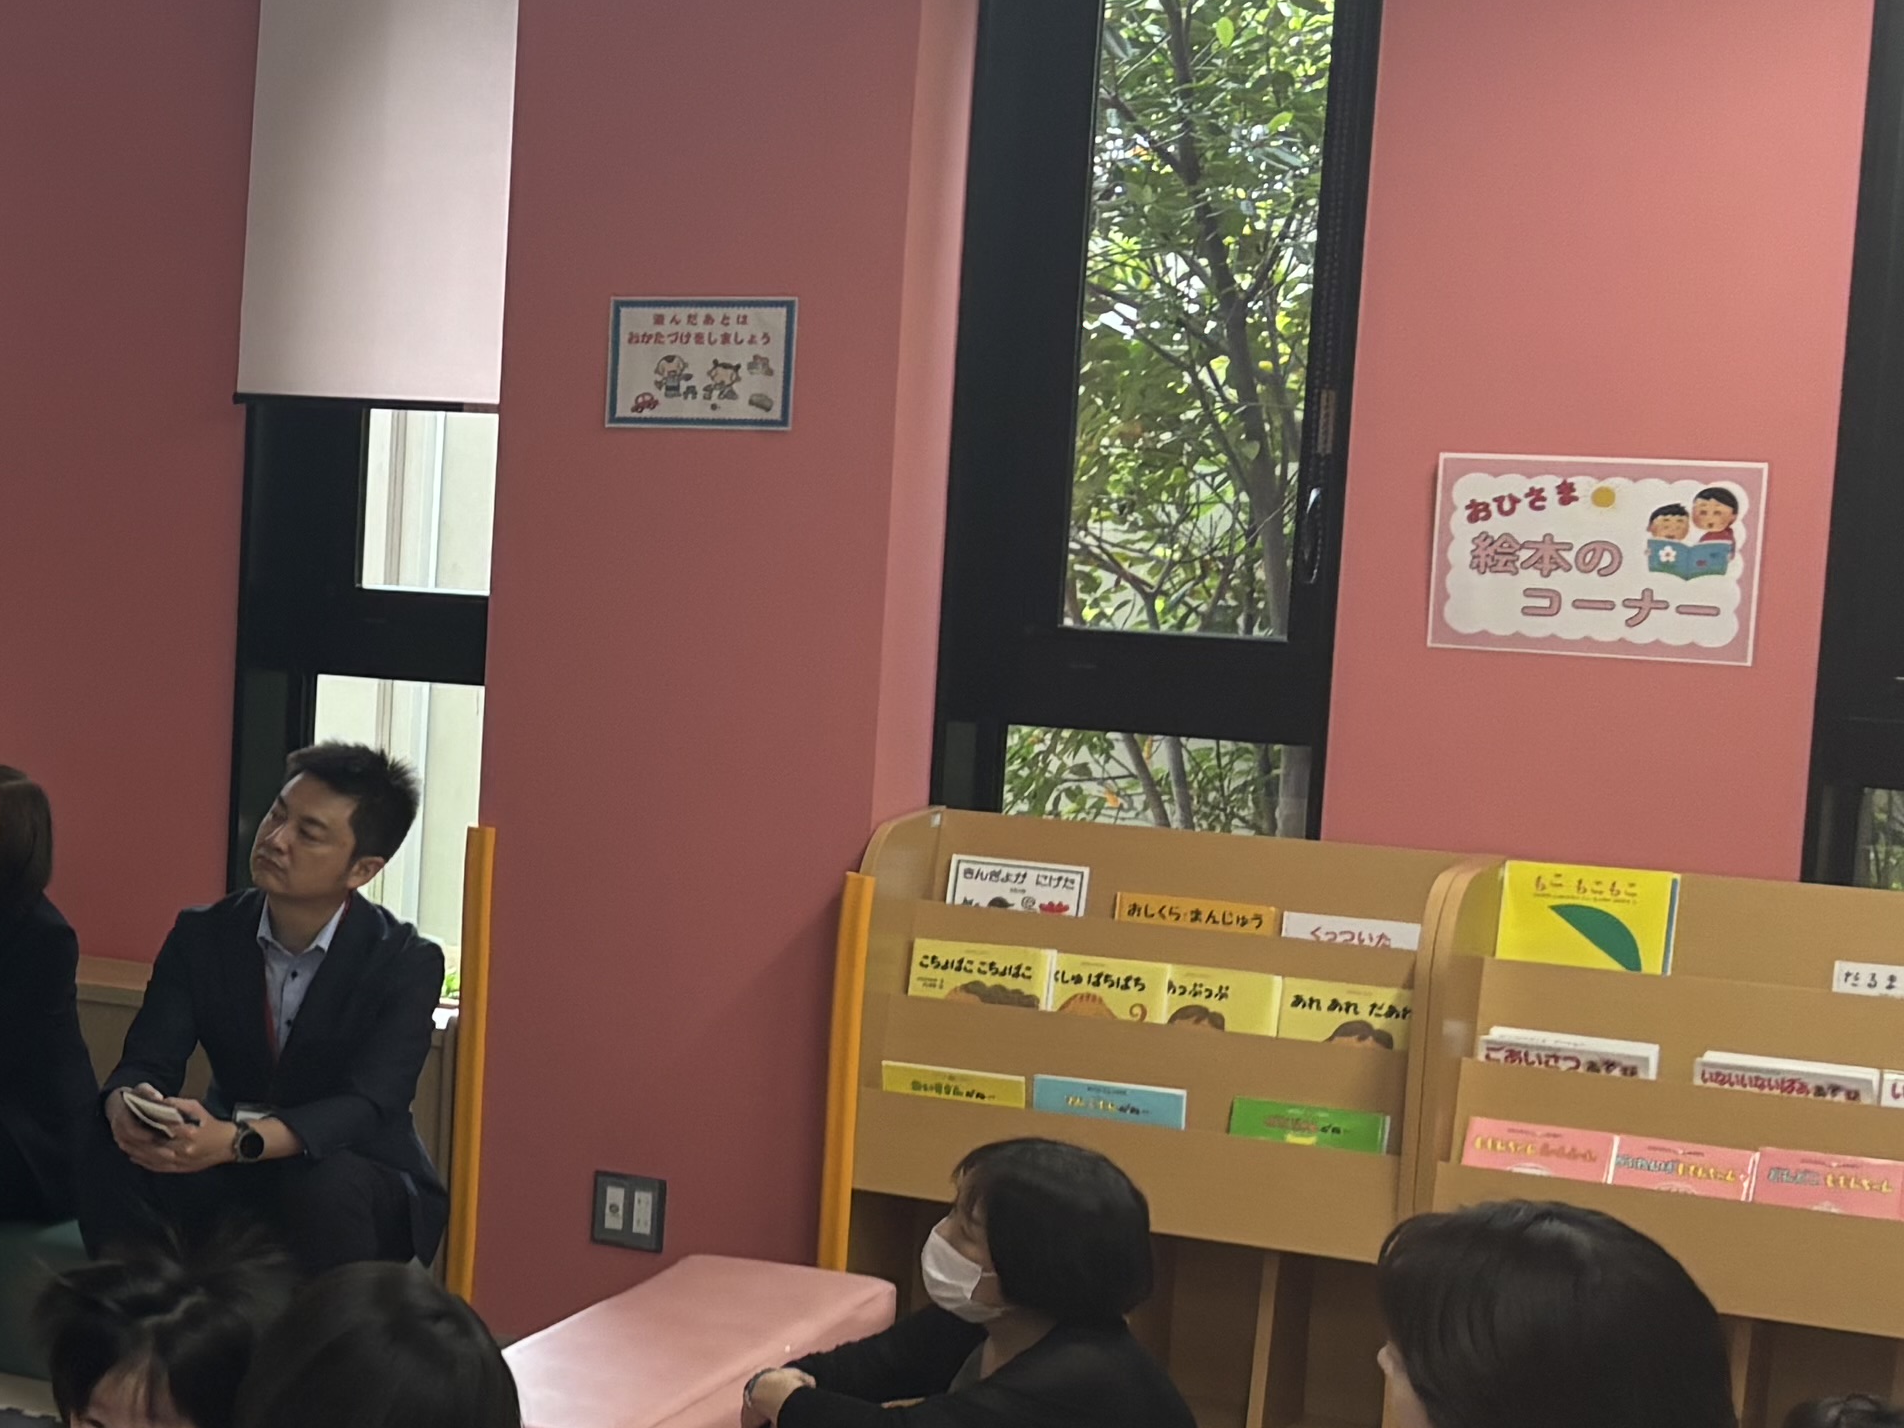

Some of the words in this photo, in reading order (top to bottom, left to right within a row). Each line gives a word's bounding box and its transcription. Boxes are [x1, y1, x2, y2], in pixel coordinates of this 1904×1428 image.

[627, 331, 771, 345] おかたづけをしましょう
[1465, 479, 1580, 524] おひさま
[1469, 531, 1623, 577] 絵本の
[1521, 587, 1720, 627] コーナー
[1035, 873, 1075, 890] にげた
[1535, 873, 1563, 891] もこ
[1577, 877, 1637, 896] もこもこ
[1291, 994, 1322, 1011] あれ
[1327, 997, 1360, 1015] あれ
